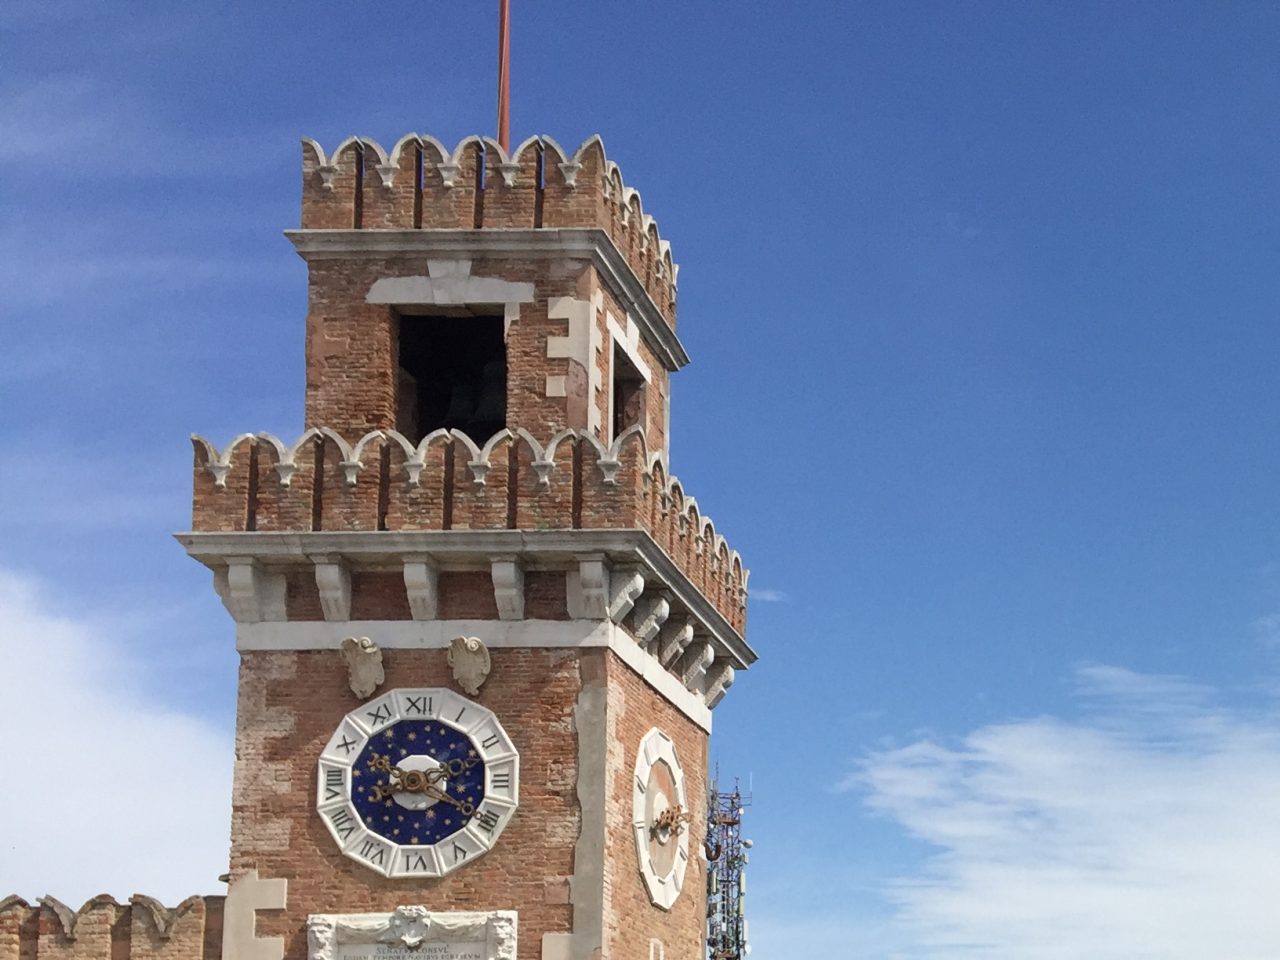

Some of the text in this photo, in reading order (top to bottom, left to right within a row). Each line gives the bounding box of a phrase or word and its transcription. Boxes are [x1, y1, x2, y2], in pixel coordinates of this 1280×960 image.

[367, 703, 392, 726] XI
[405, 696, 433, 715] XII
[455, 706, 466, 722] I
[336, 734, 357, 755] X
[482, 733, 499, 749] II
[492, 772, 510, 789] III
[331, 809, 356, 841] VIII
[360, 841, 384, 866] VII
[453, 841, 467, 860] V
[405, 853, 428, 871] VI
